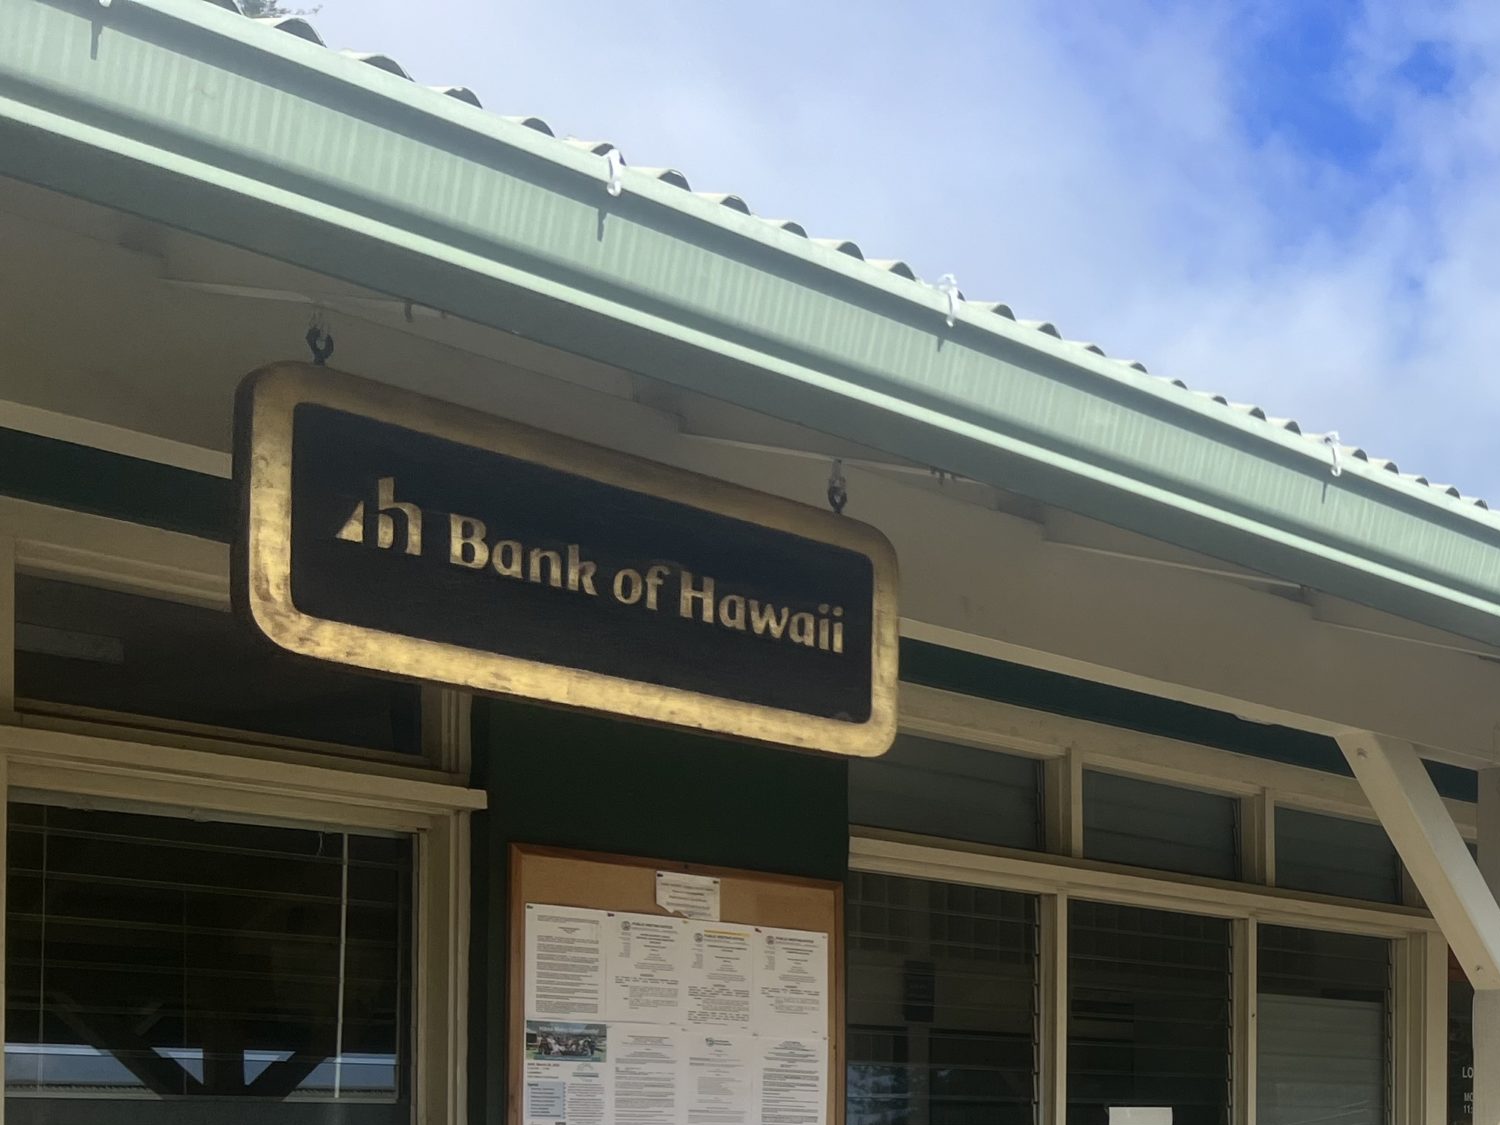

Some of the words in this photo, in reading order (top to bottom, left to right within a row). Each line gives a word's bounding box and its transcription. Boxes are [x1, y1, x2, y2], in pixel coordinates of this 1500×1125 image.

[448, 512, 599, 597] Bank
[612, 564, 671, 611] of
[679, 569, 844, 653] Hawaii
